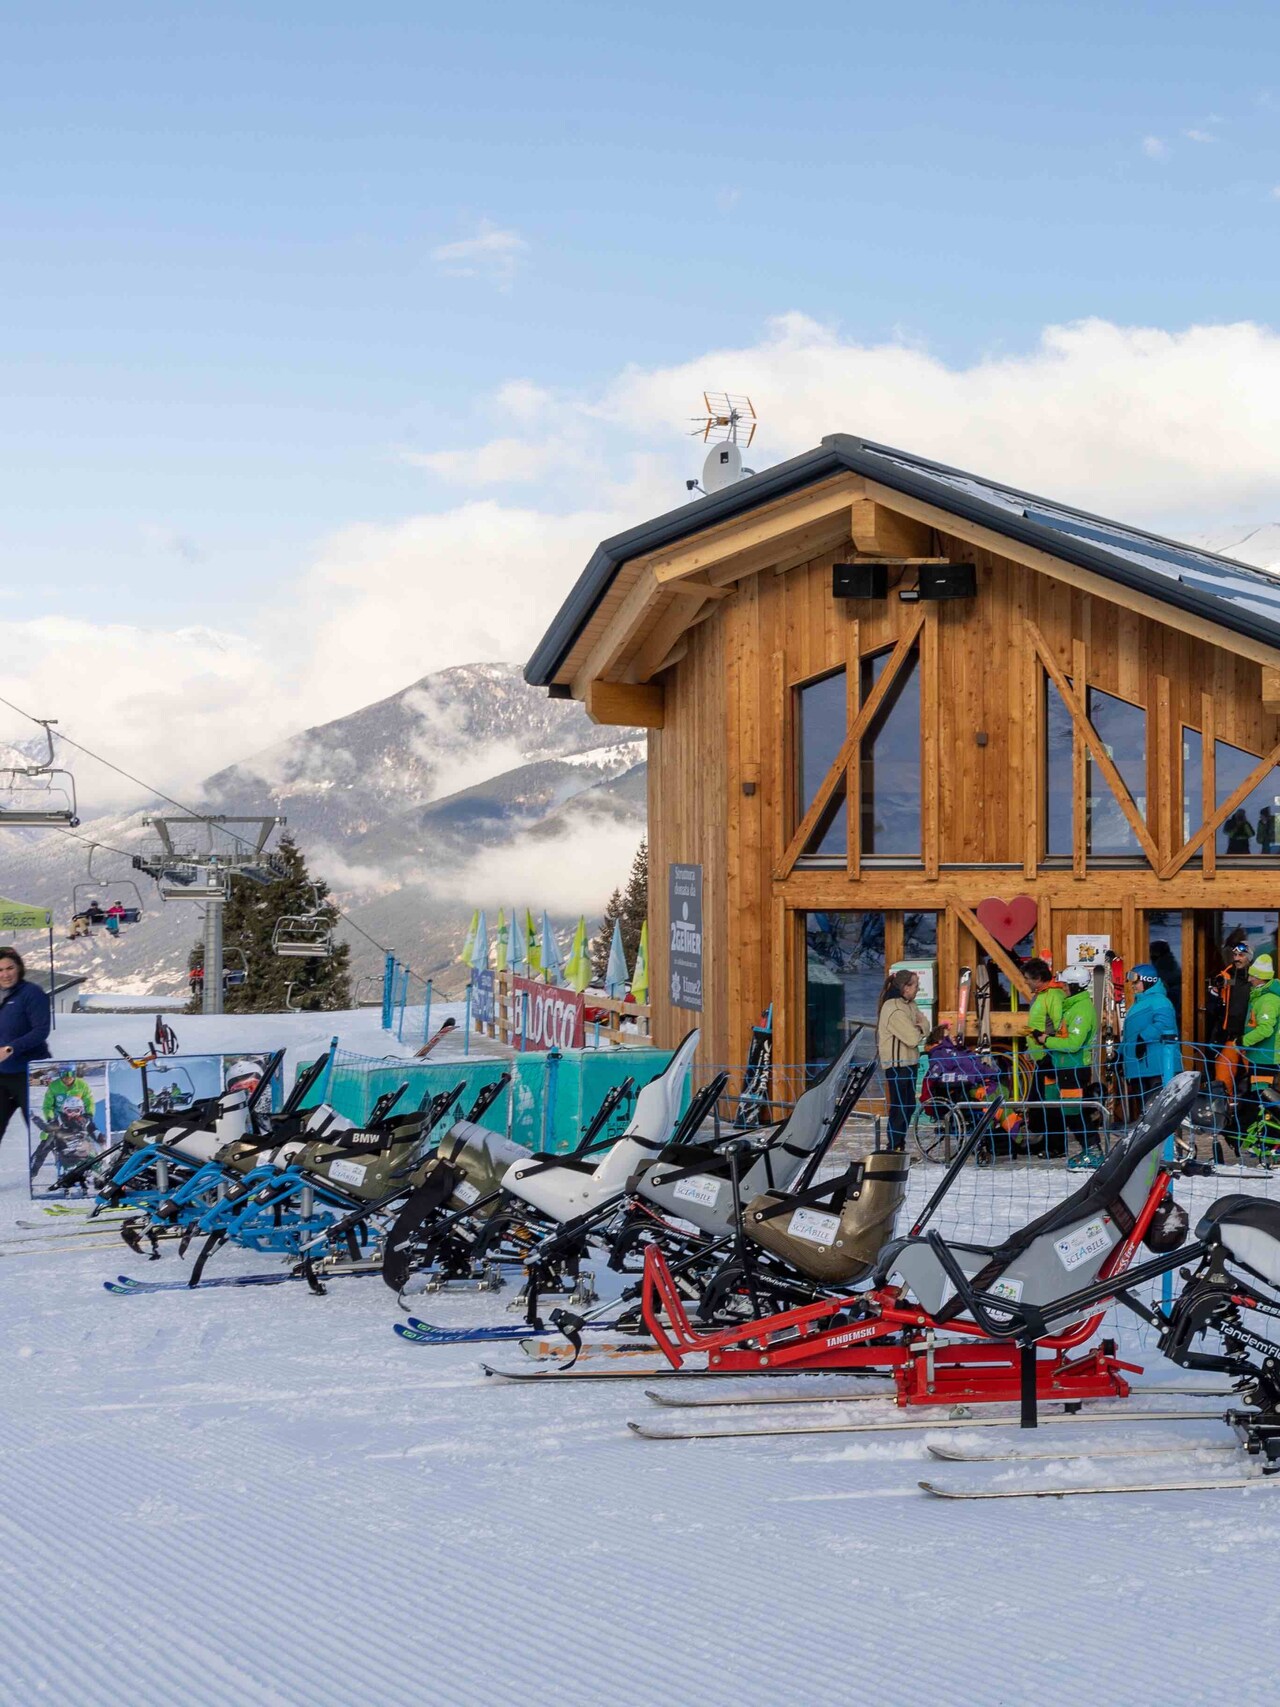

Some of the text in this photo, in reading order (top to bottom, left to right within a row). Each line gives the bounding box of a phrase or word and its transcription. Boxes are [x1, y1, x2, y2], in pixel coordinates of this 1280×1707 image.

[671, 920, 701, 956] 2GETHER
[514, 989, 577, 1050] BLOCCO
[352, 1133, 380, 1144] BMW
[676, 1186, 712, 1202] SCIABILE
[792, 1222, 831, 1240] SCIABILE
[1066, 1238, 1105, 1266] SCIABILE
[826, 1326, 876, 1347] TANDEMSKI
